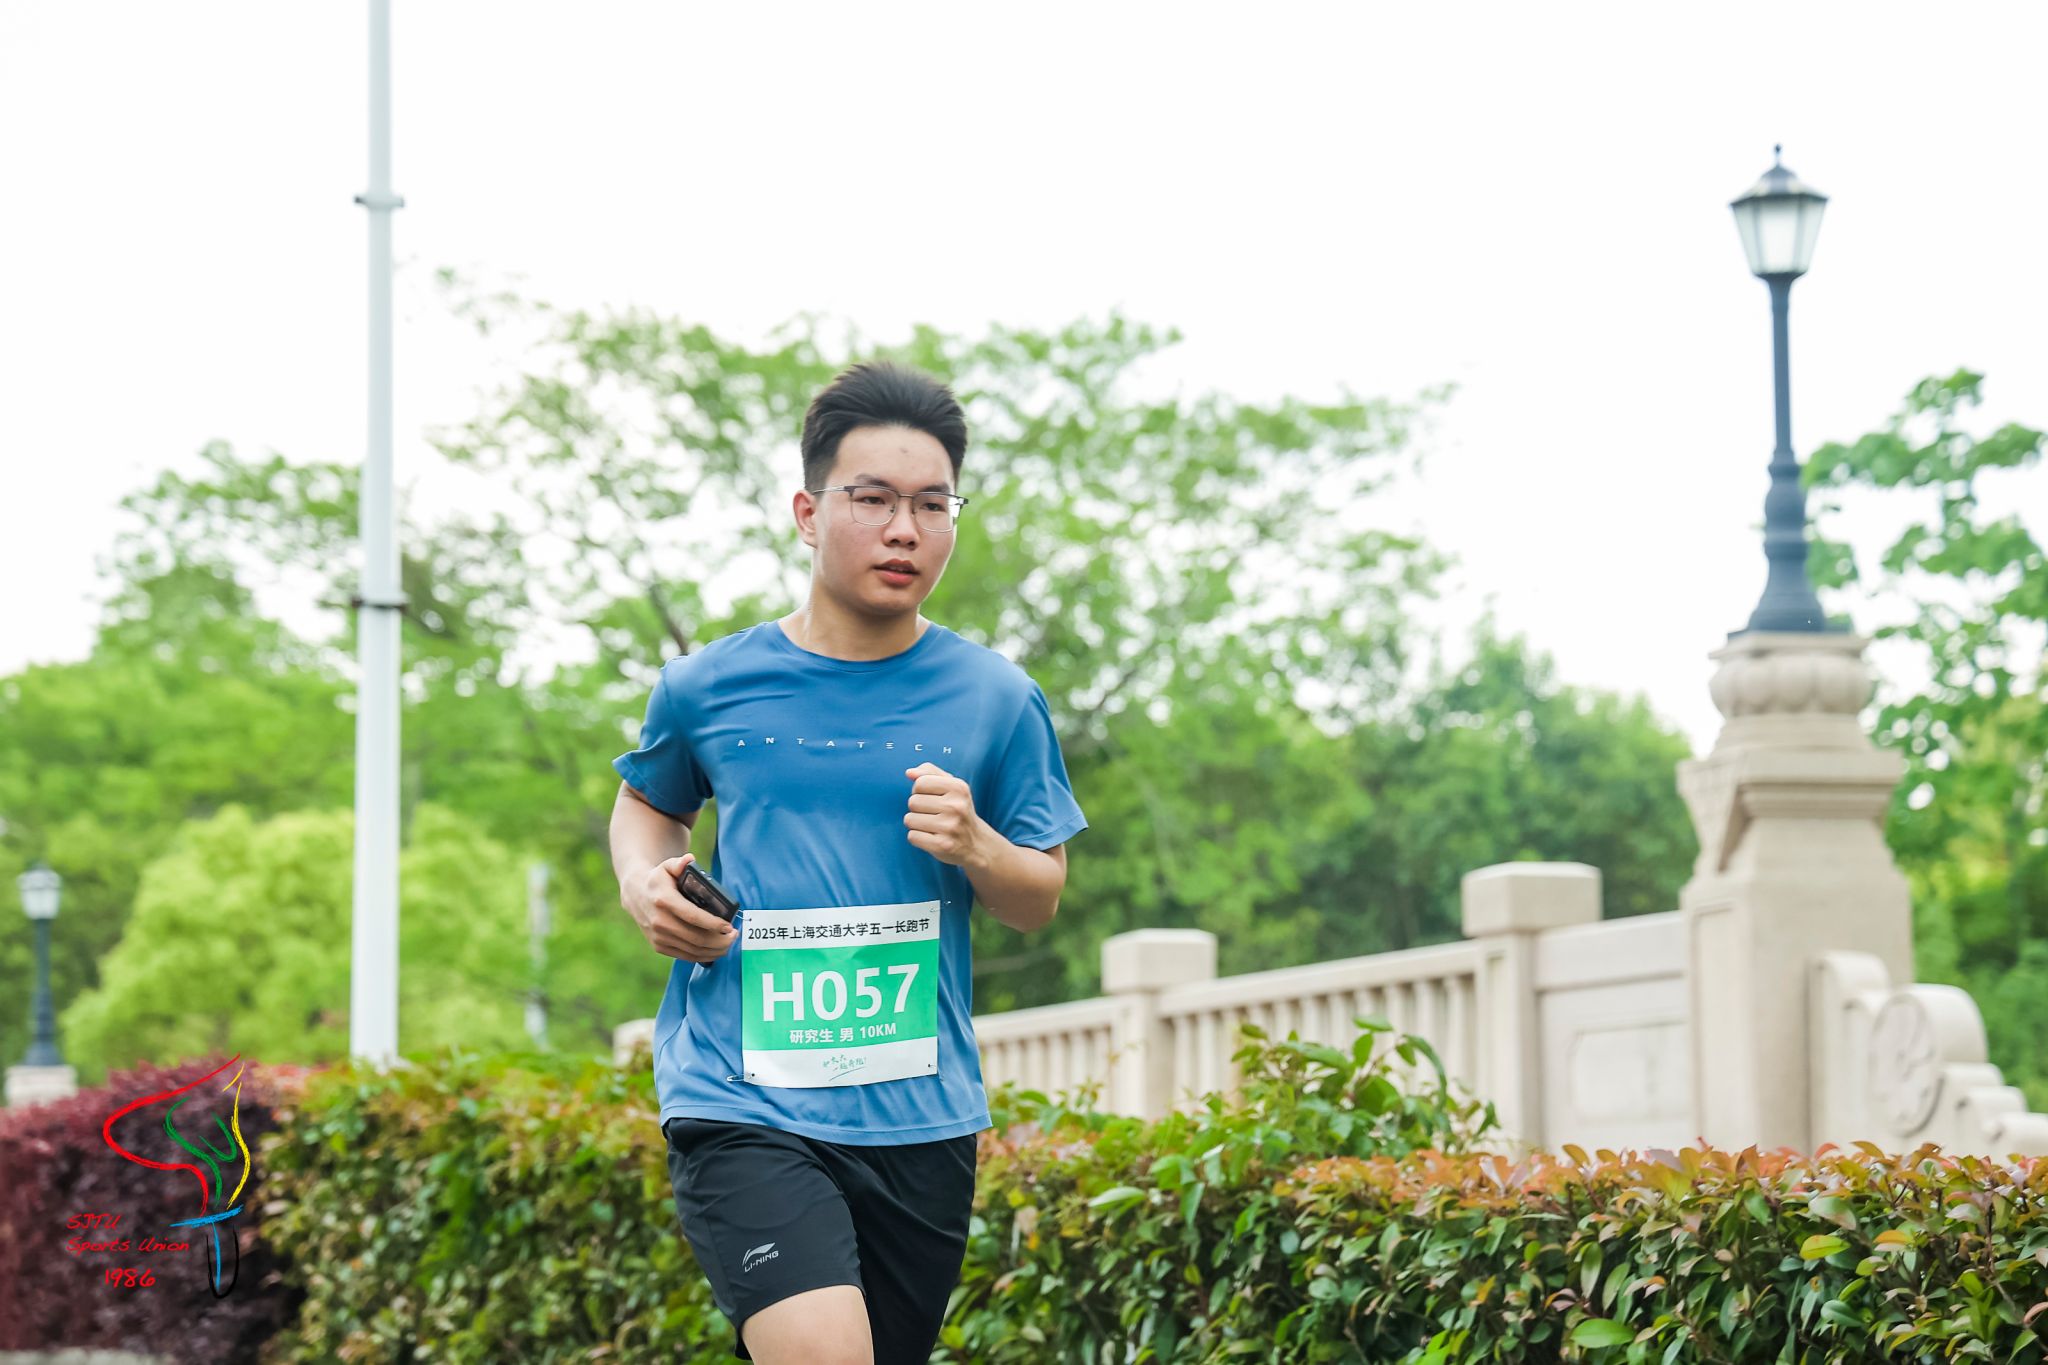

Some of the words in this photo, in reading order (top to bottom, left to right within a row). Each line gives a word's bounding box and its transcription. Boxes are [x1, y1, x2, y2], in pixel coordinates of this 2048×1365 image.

[748, 918, 930, 940] 2025年上海交通大学五一长跑节
[761, 963, 920, 1022] H057
[789, 1029, 834, 1044] 研究生
[839, 1027, 854, 1042] 男
[859, 1023, 897, 1039] 10KM
[744, 1250, 779, 1273] LI-NING
